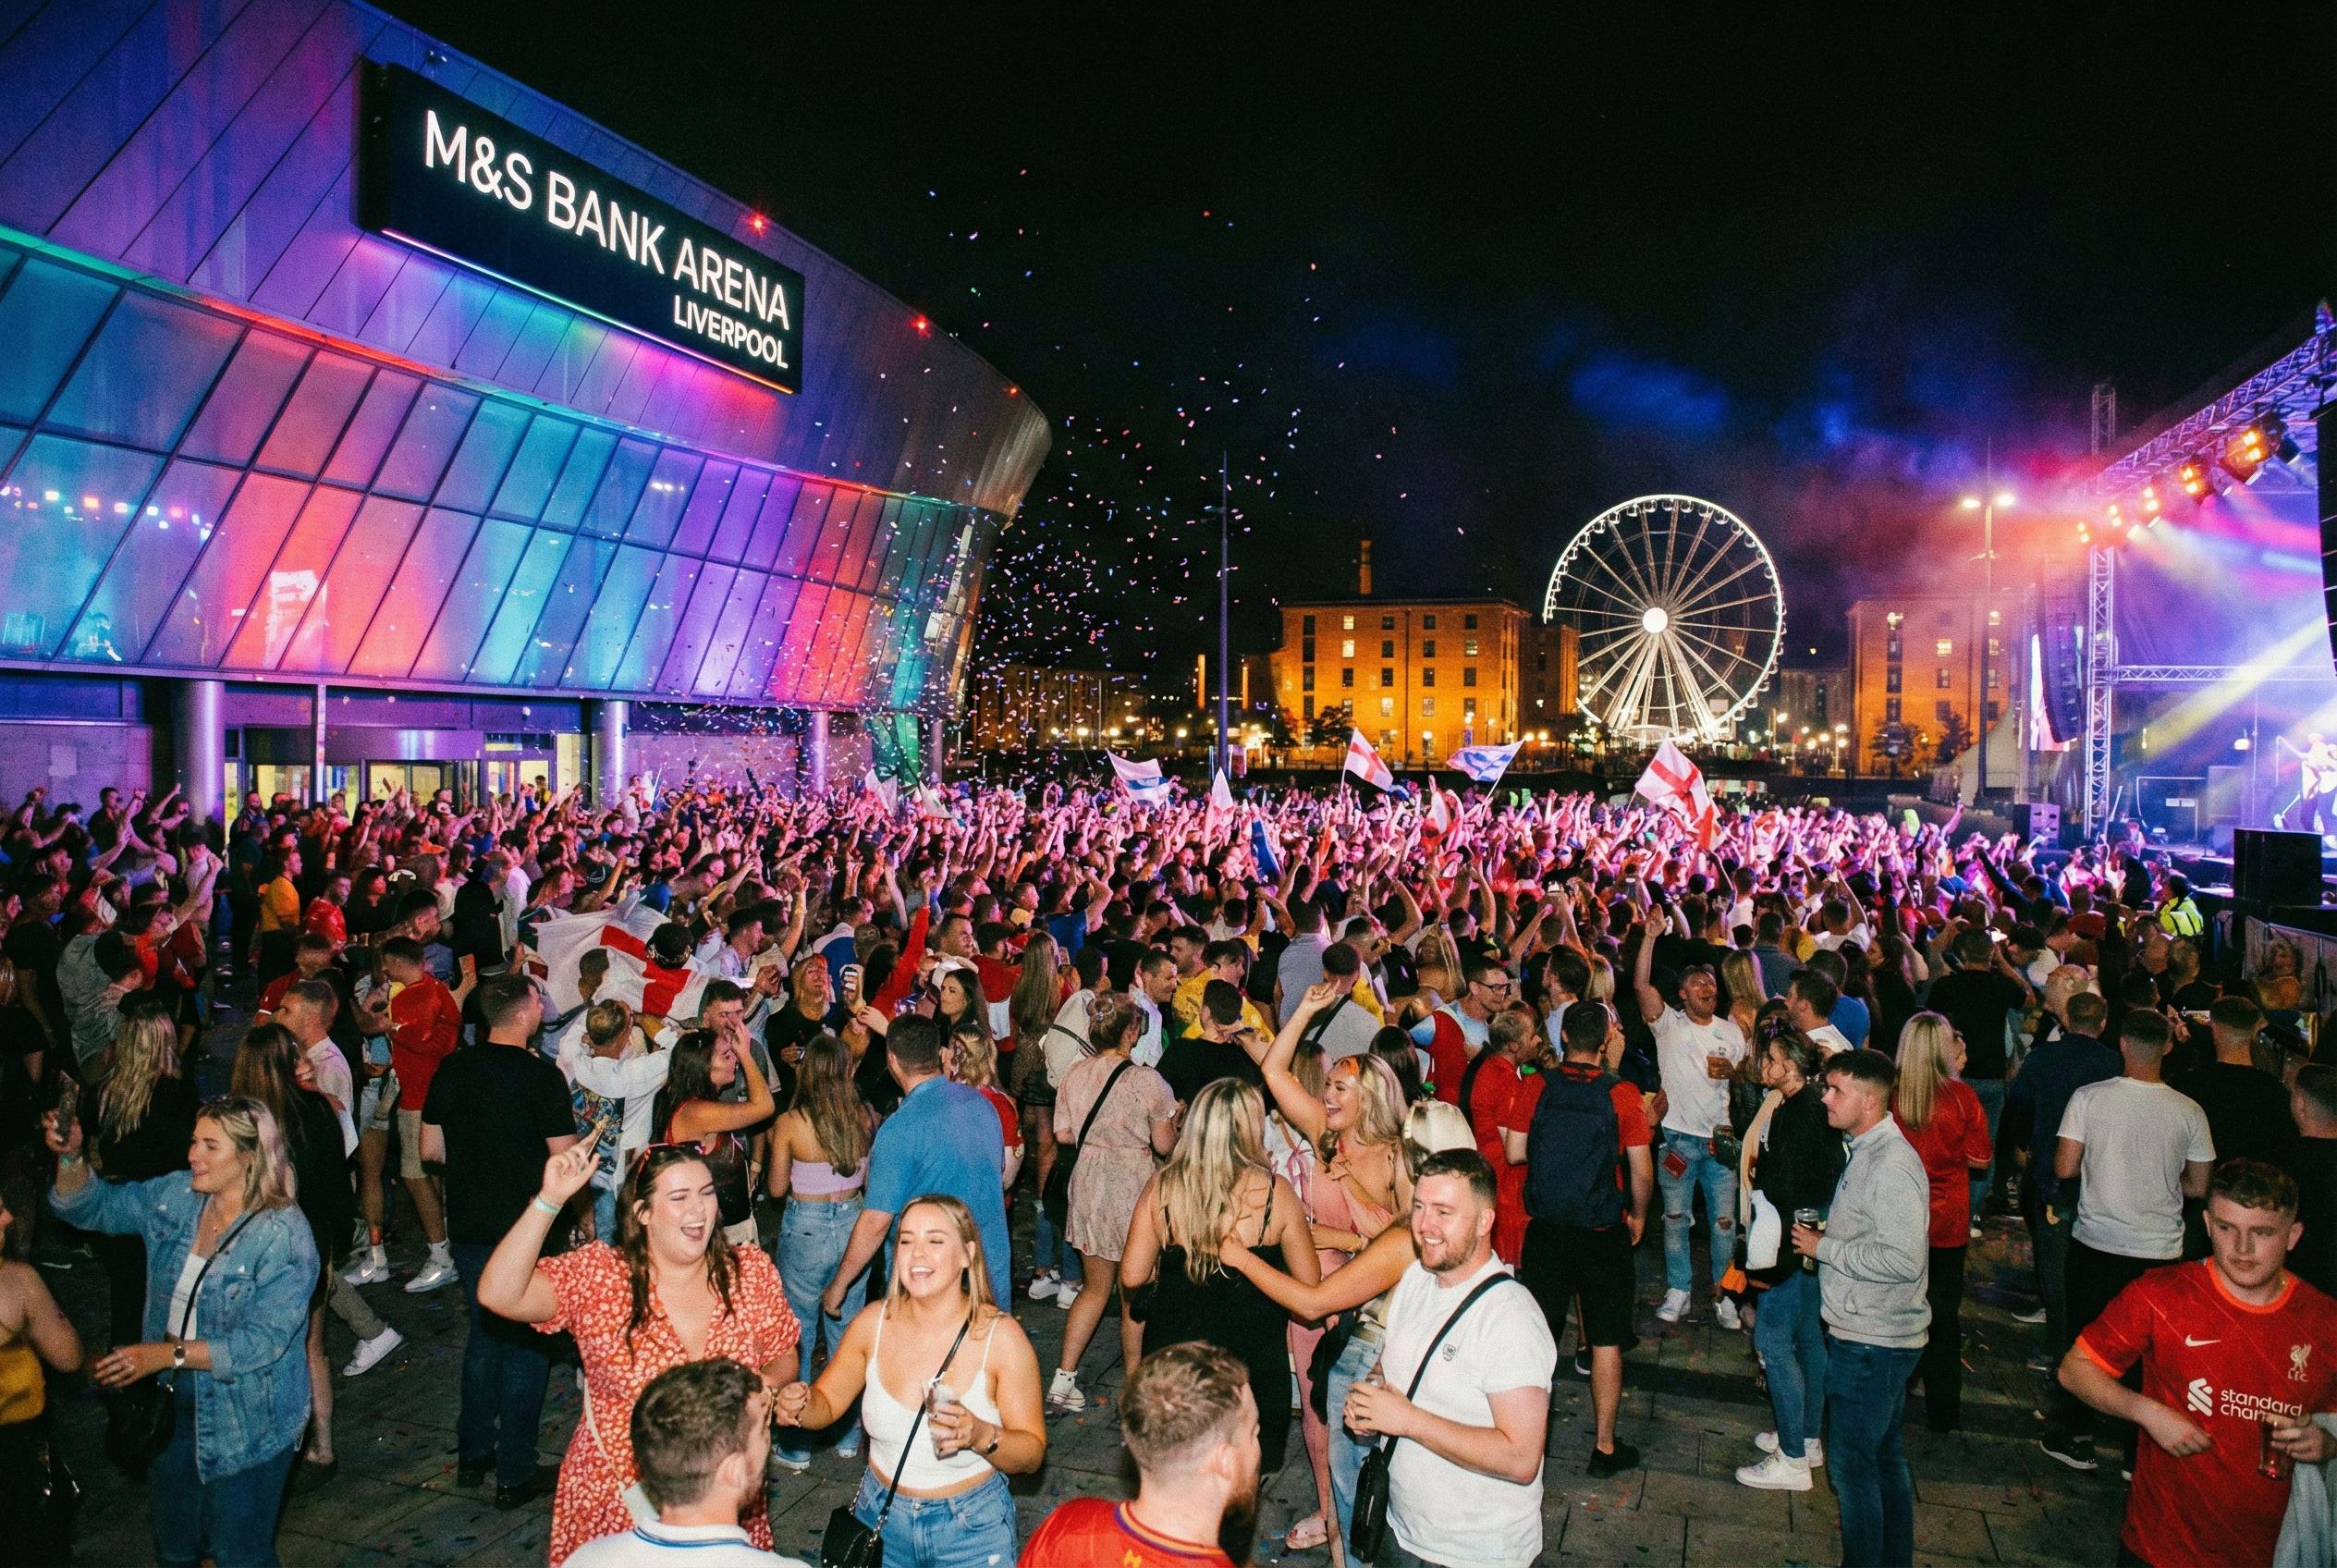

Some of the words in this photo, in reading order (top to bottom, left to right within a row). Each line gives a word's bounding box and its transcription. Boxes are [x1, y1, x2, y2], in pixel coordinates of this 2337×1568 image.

[425, 109, 533, 210] M&S
[547, 170, 666, 275] BANK
[673, 238, 789, 331] ARENA
[674, 294, 789, 369] LIVERPOOL
[2221, 1389, 2303, 1416] standard
